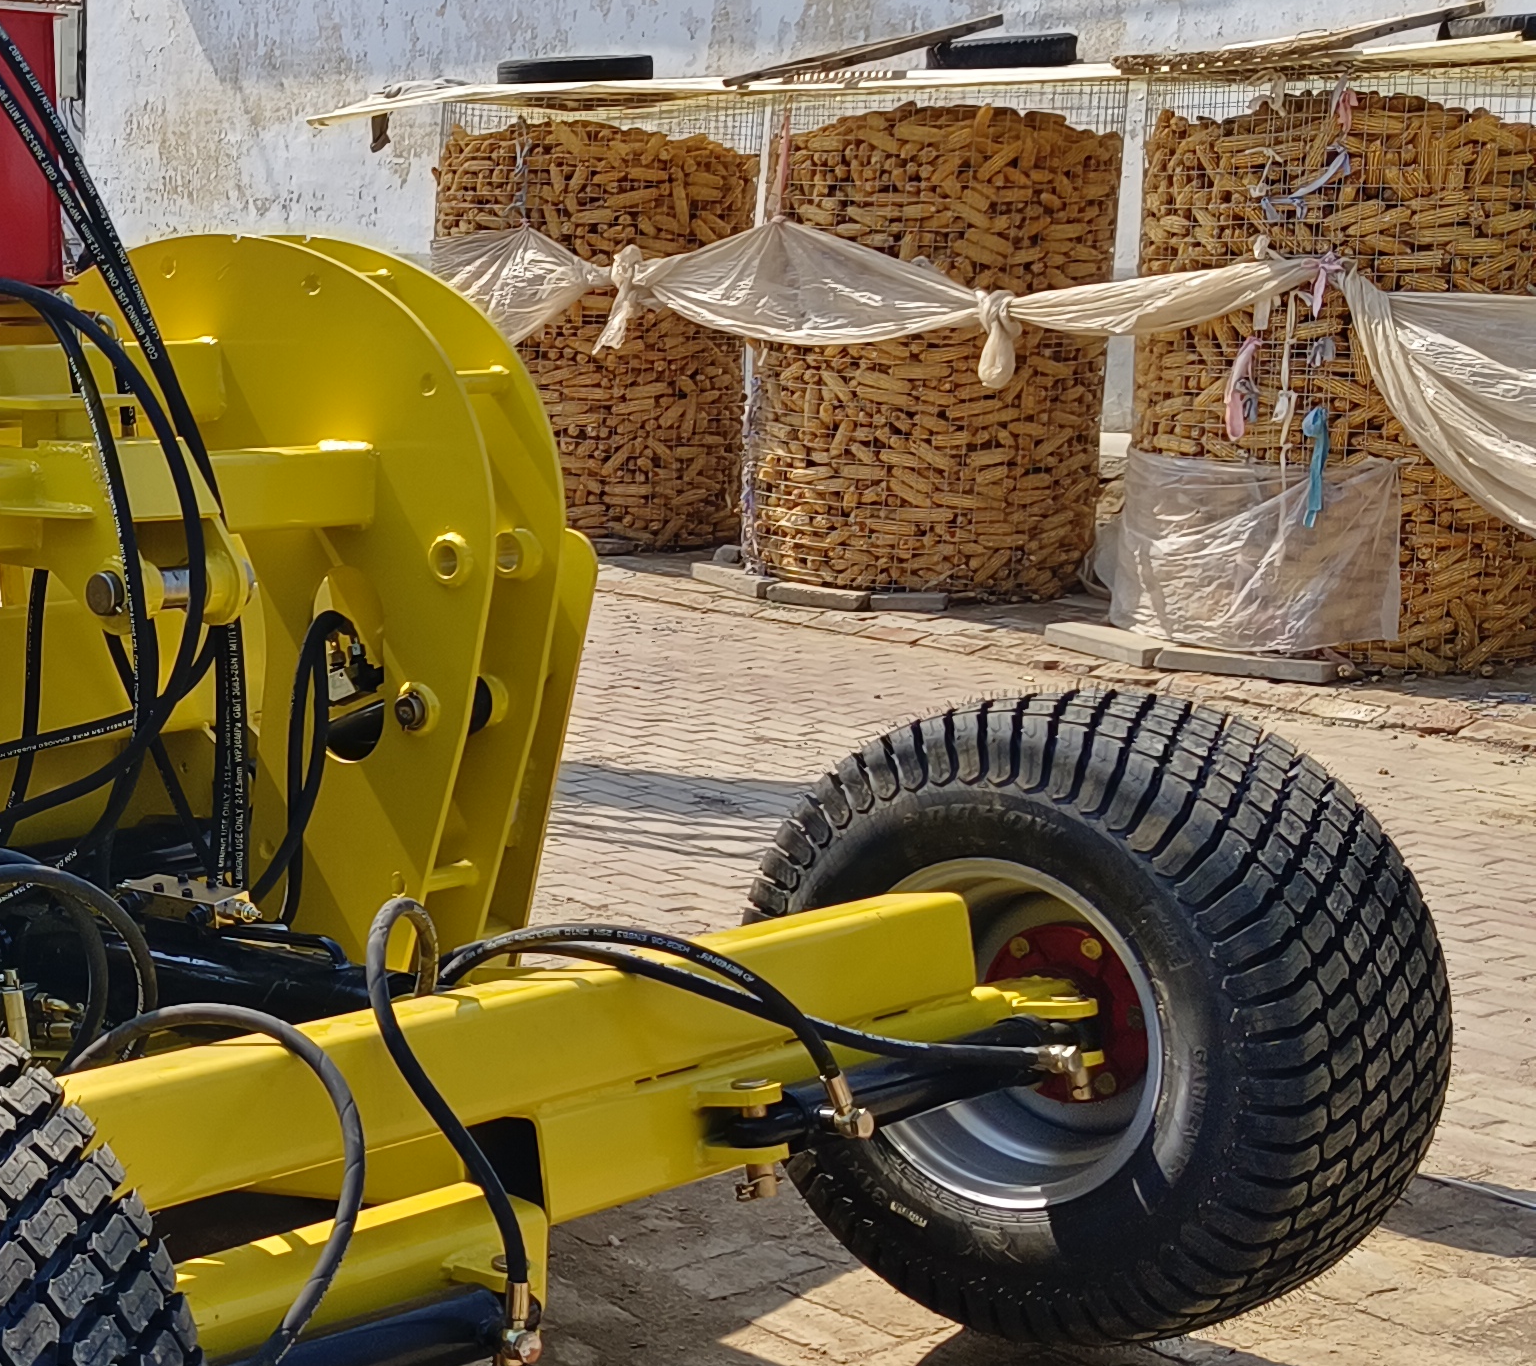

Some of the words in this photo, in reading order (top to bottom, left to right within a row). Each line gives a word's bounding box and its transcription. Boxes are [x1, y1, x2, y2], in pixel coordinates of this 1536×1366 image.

[3, 100, 20, 120] MT/T
[40, 159, 58, 181] GB/T
[112, 239, 128, 264] ONLY
[100, 261, 120, 287] ONLY
[123, 264, 136, 283] USE
[114, 286, 129, 305] USE
[124, 304, 146, 336] MINING
[140, 334, 159, 360] COAL
[232, 697, 241, 718] GB/T
[234, 808, 243, 830] ONLY
[235, 833, 243, 848] USE
